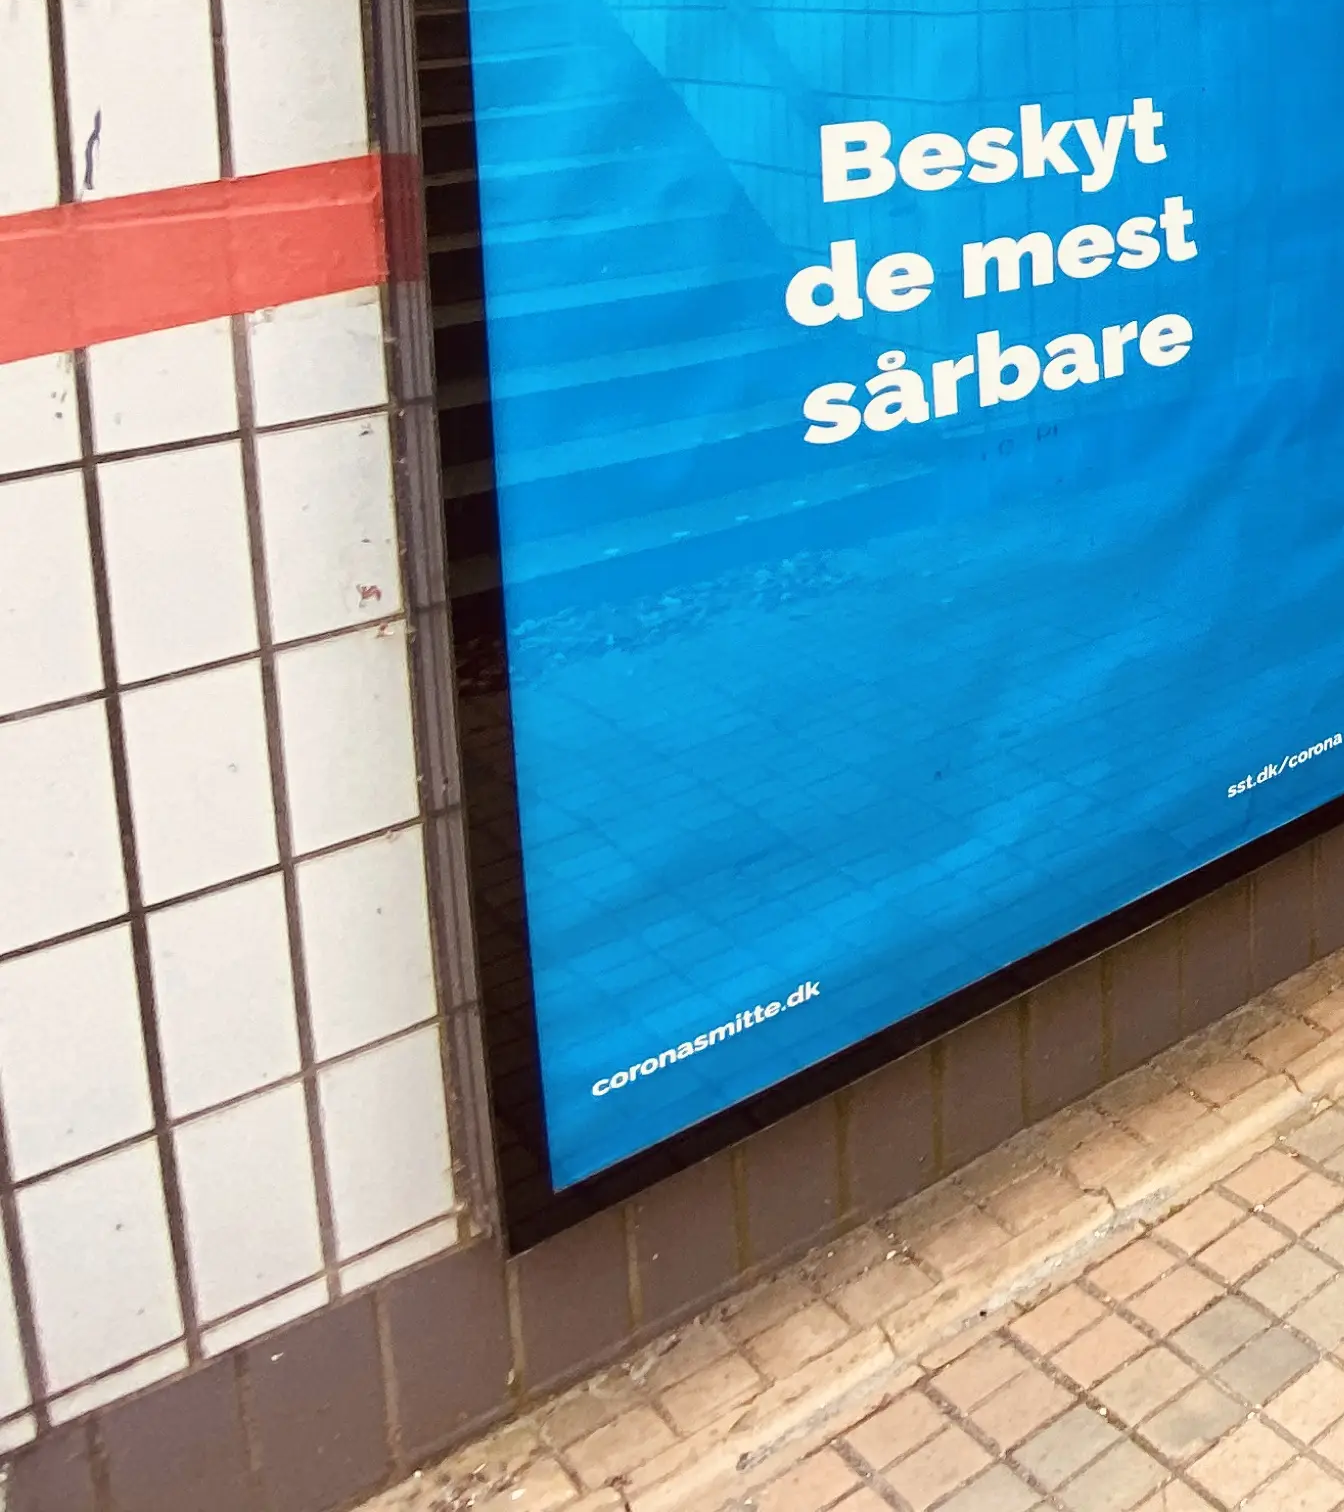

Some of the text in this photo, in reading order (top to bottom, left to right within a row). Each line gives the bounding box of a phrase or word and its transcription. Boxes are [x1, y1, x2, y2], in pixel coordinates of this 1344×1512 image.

[819, 97, 1168, 204] Beskyt
[785, 195, 1199, 327] de mest
[801, 313, 1194, 445] sårbare
[1227, 732, 1343, 799] sst.dk/corona
[591, 980, 821, 1097] coronasmitte.dk
